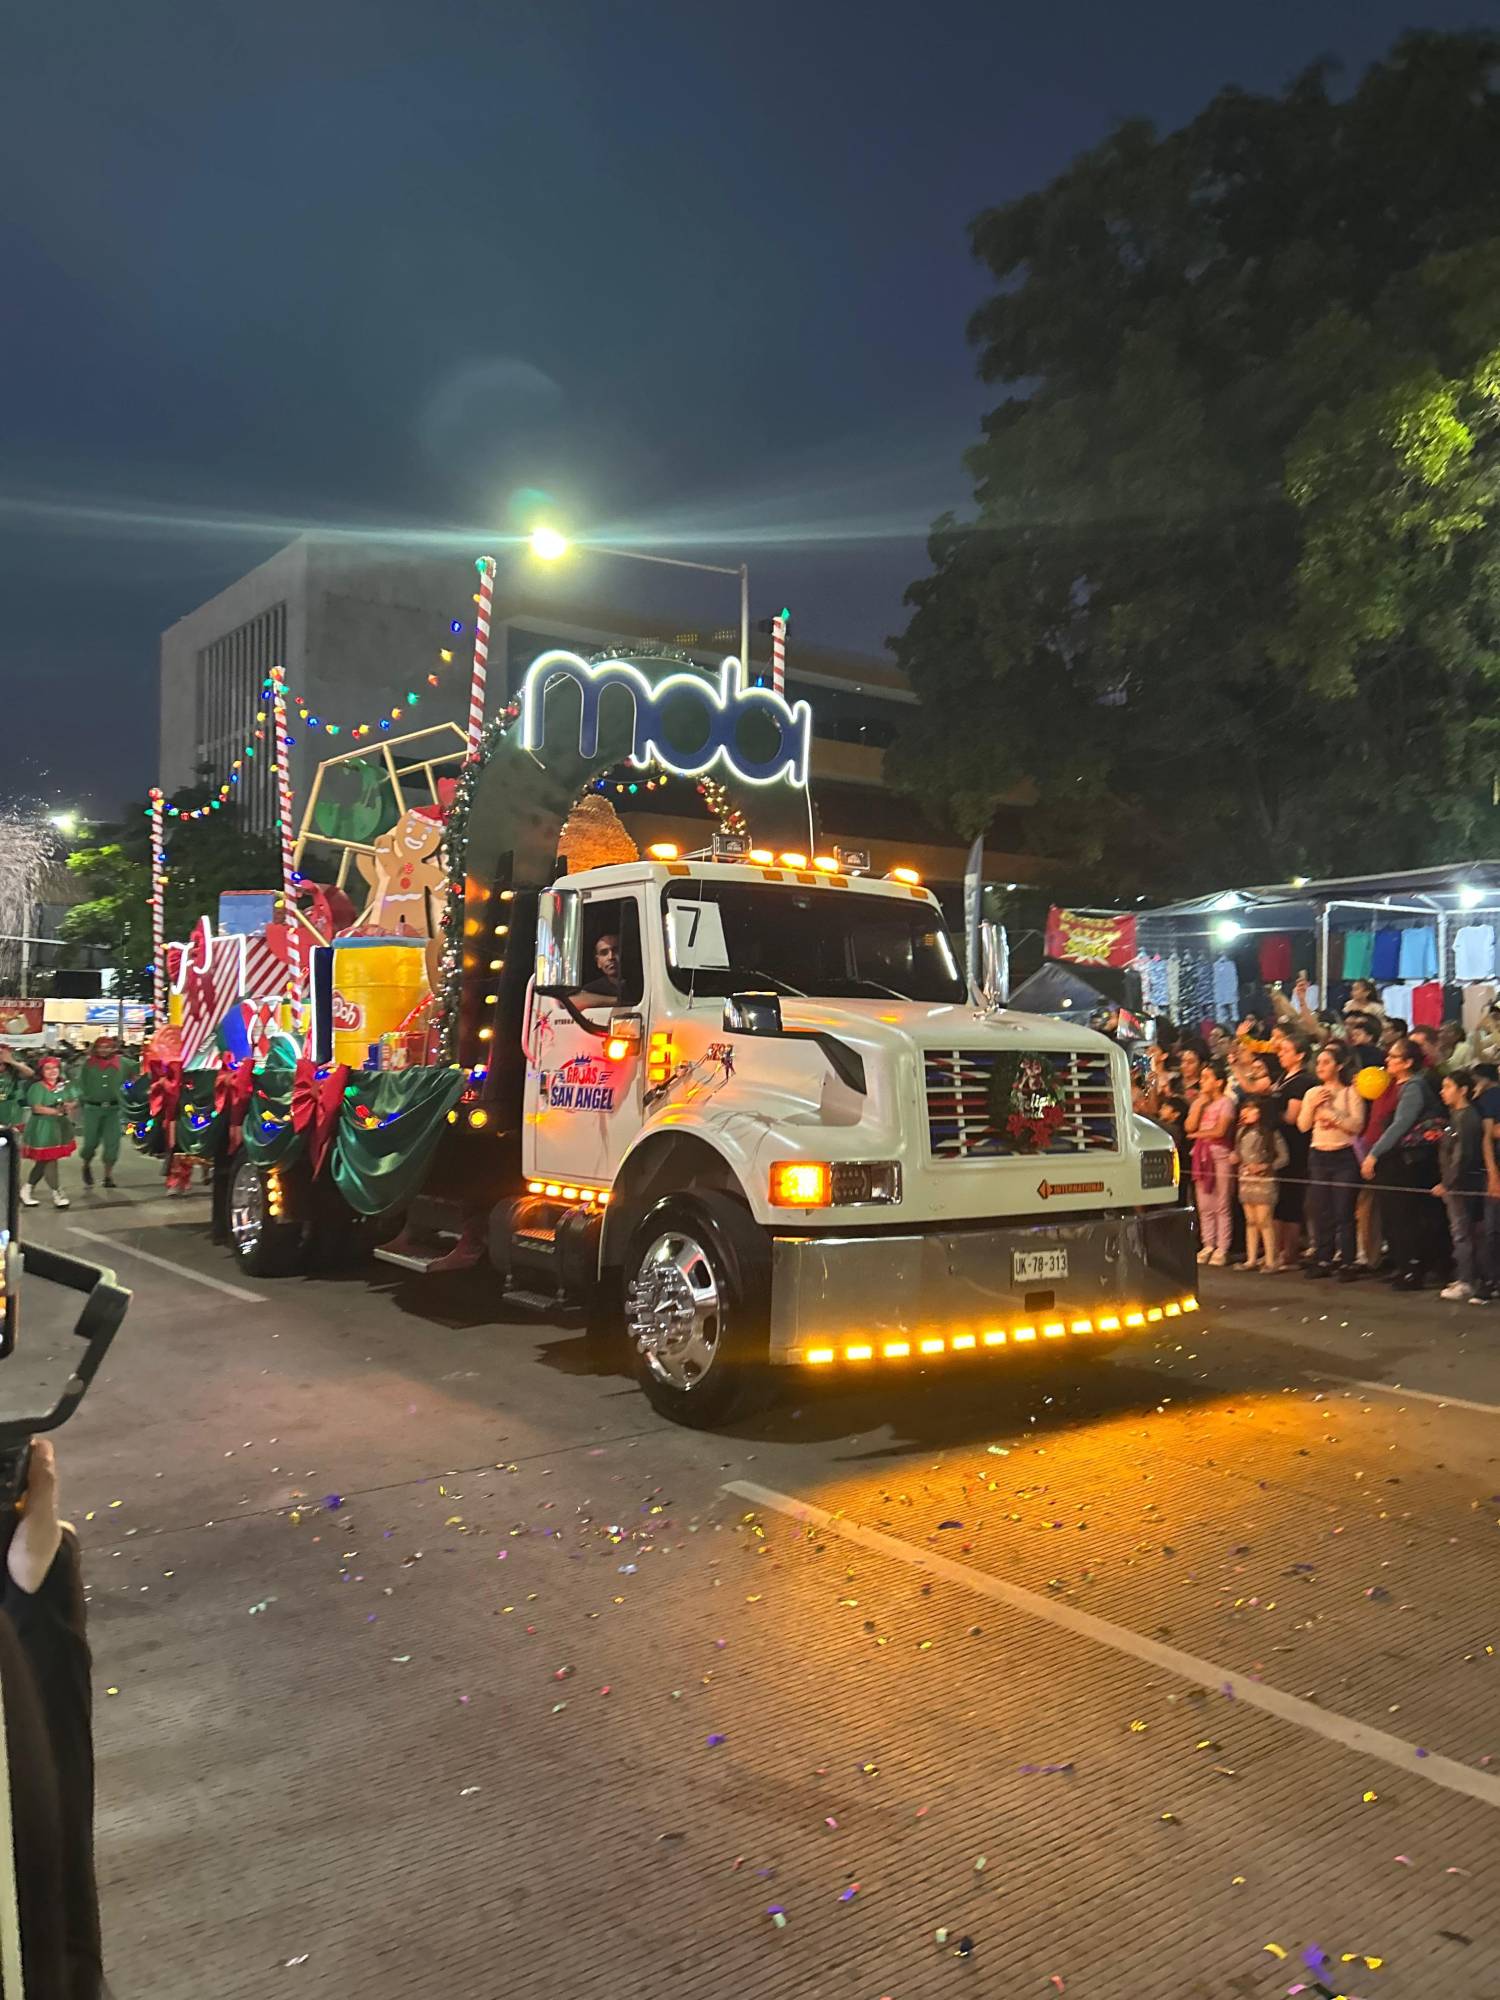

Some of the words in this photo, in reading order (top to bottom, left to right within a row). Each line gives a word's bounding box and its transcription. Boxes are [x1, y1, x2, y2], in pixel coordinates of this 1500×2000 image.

[676, 905, 701, 948] 7
[551, 1086, 574, 1107] SAN
[575, 1087, 615, 1110] ANGEL
